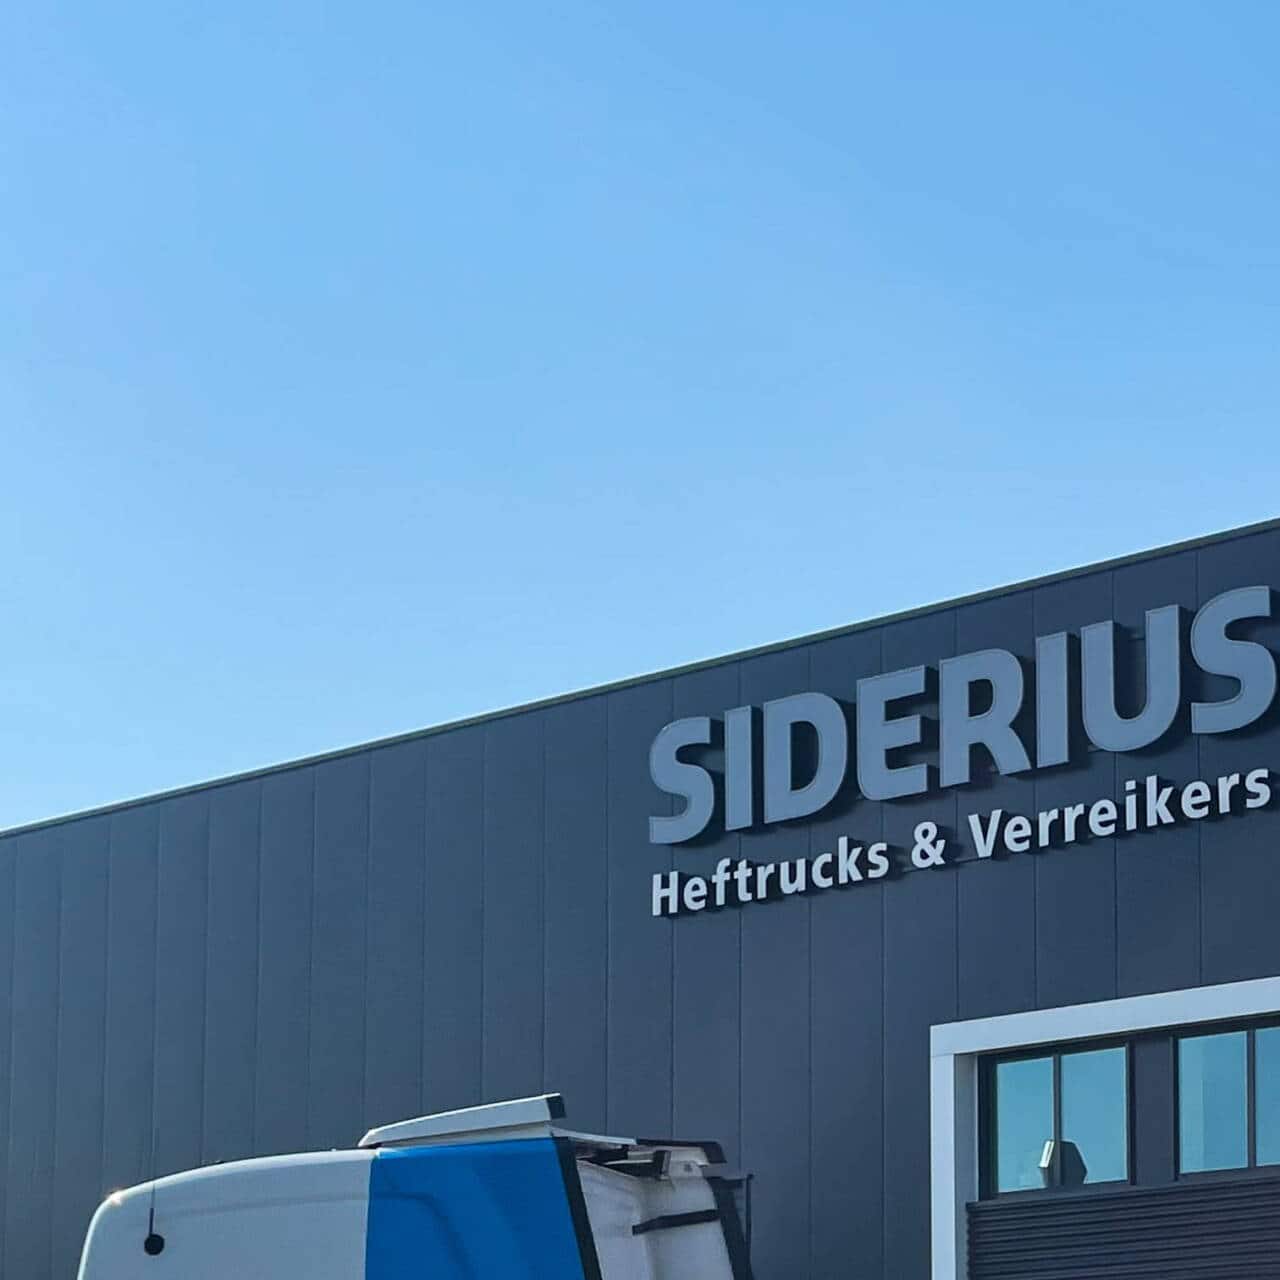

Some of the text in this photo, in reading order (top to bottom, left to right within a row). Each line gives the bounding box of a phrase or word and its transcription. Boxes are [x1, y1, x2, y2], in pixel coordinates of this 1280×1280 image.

[649, 585, 1277, 844] SIDERIUS
[651, 767, 1272, 916] Heftrucks & Verreikers
